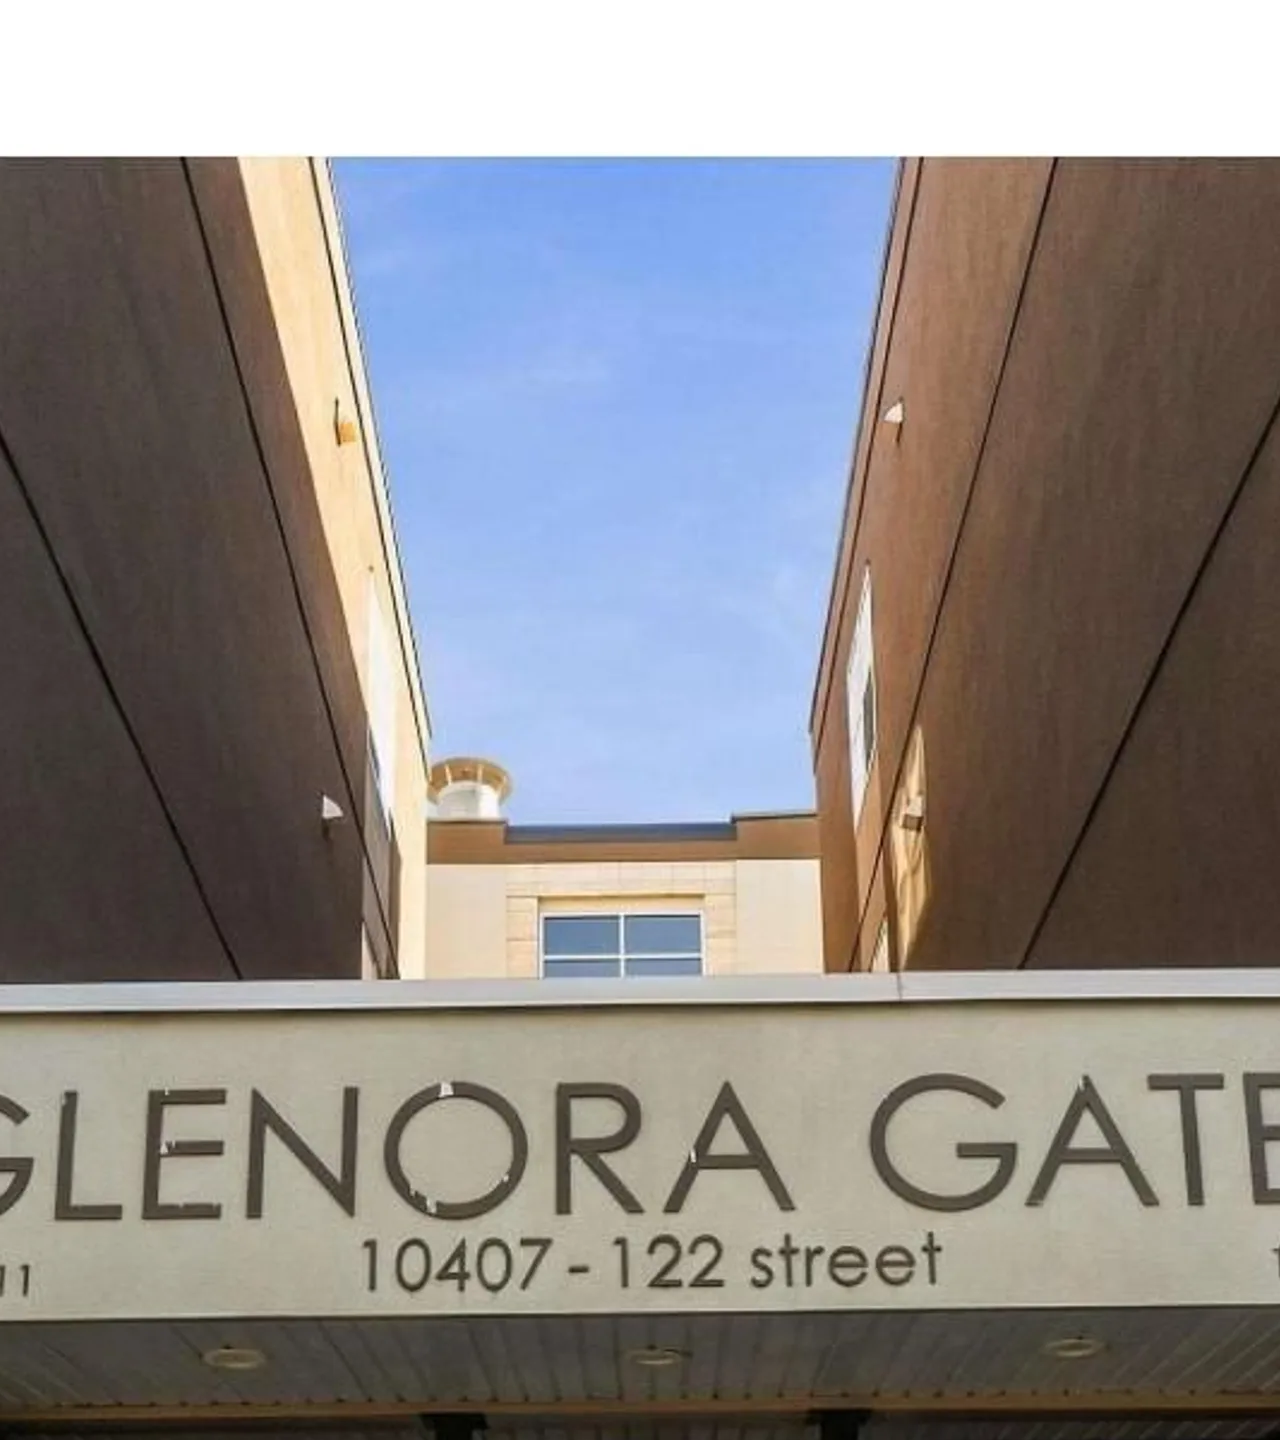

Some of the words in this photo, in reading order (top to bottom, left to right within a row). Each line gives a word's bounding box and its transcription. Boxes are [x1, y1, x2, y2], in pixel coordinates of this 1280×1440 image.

[362, 1237, 554, 1293] 10407
[612, 1233, 725, 1289] 122
[749, 1230, 943, 1289] street
